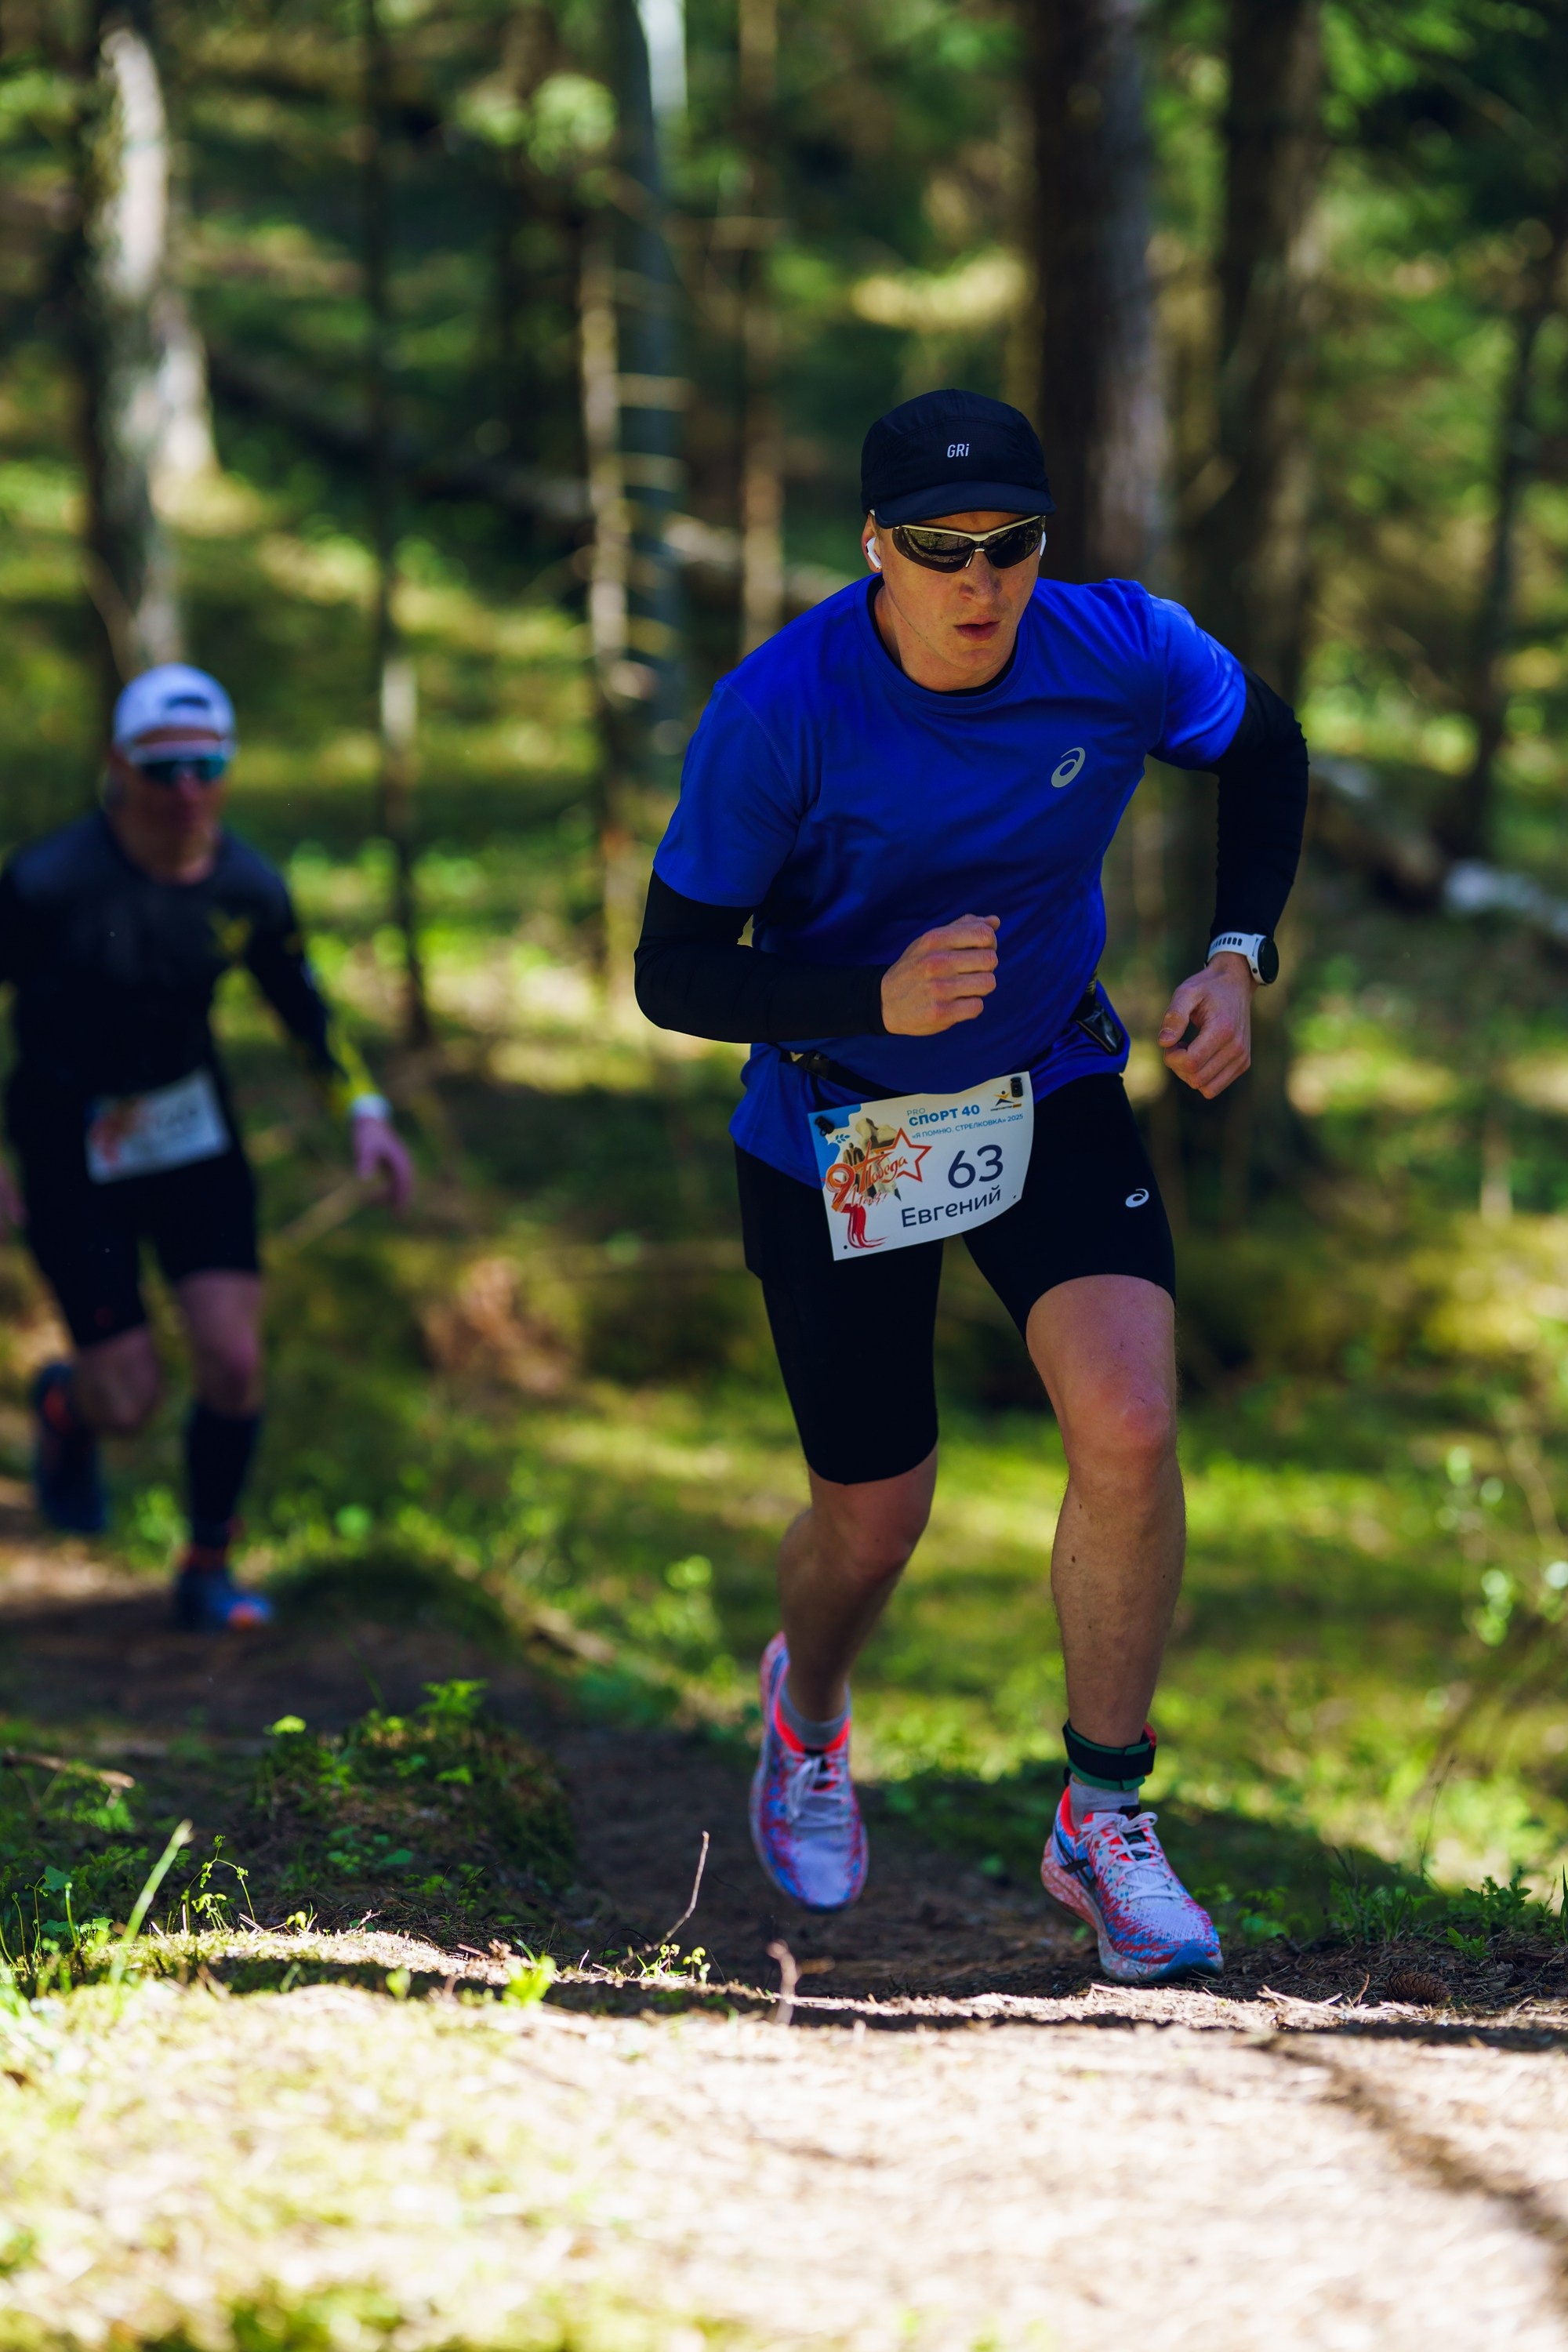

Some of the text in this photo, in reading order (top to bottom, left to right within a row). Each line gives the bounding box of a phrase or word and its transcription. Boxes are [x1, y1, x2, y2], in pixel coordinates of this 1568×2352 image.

[906, 1107, 926, 1116] PRO
[909, 1108, 958, 1127] СПОРТ
[962, 1104, 980, 1116] 40
[922, 1126, 953, 1138] ПОМНЮ.
[1007, 1113, 1024, 1123] 2025
[947, 1144, 1004, 1189] 63
[826, 1163, 855, 1212] 9
[902, 1185, 1001, 1228] Евгений
